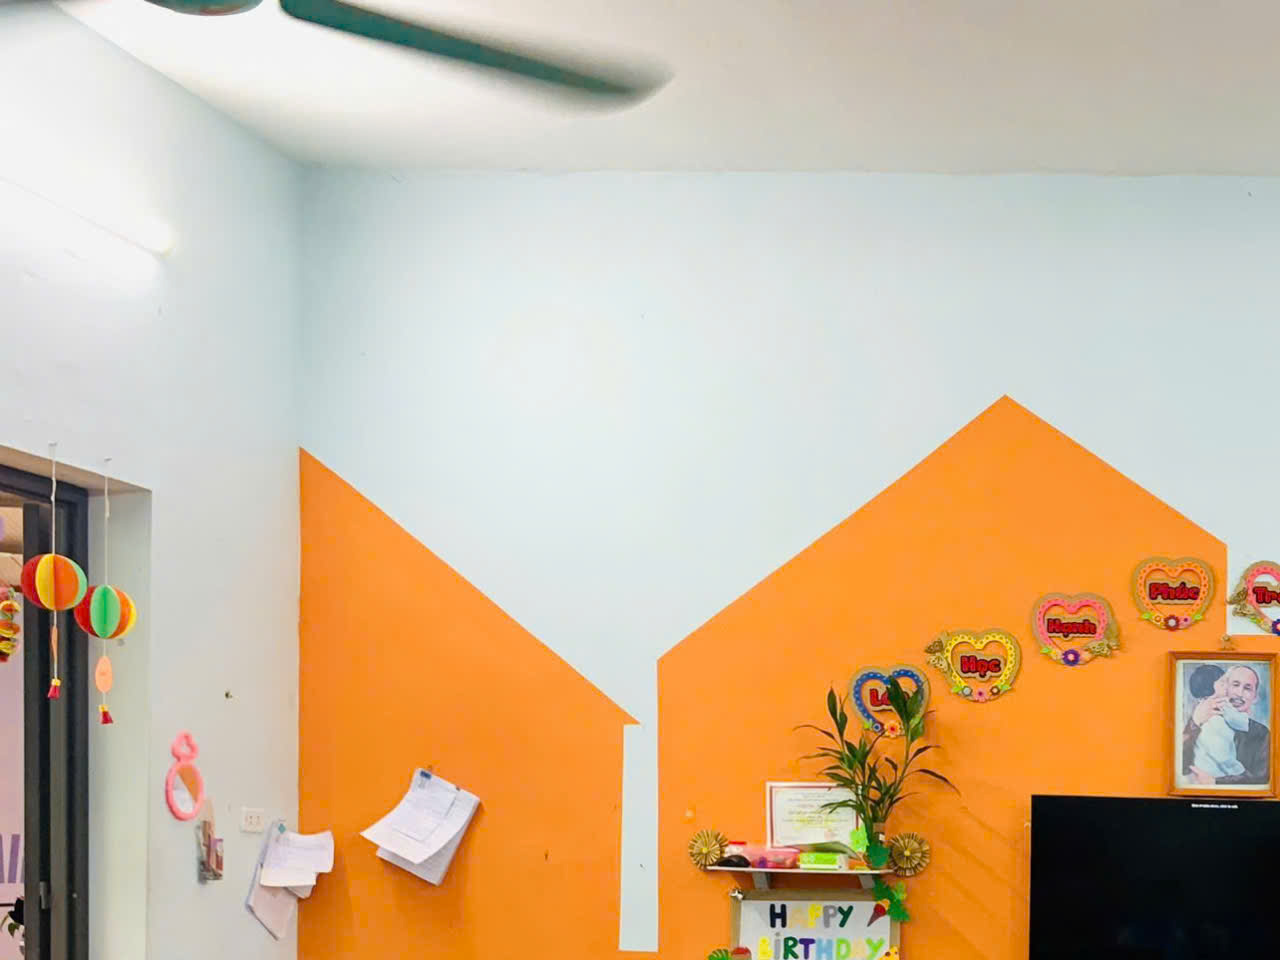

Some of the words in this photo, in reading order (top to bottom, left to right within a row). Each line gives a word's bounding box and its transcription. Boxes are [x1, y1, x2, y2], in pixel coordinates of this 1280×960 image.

[960, 654, 1001, 678] Học
[1046, 617, 1097, 638] Hạnh
[1148, 581, 1200, 601] Phúc
[769, 903, 854, 928] HAPPY
